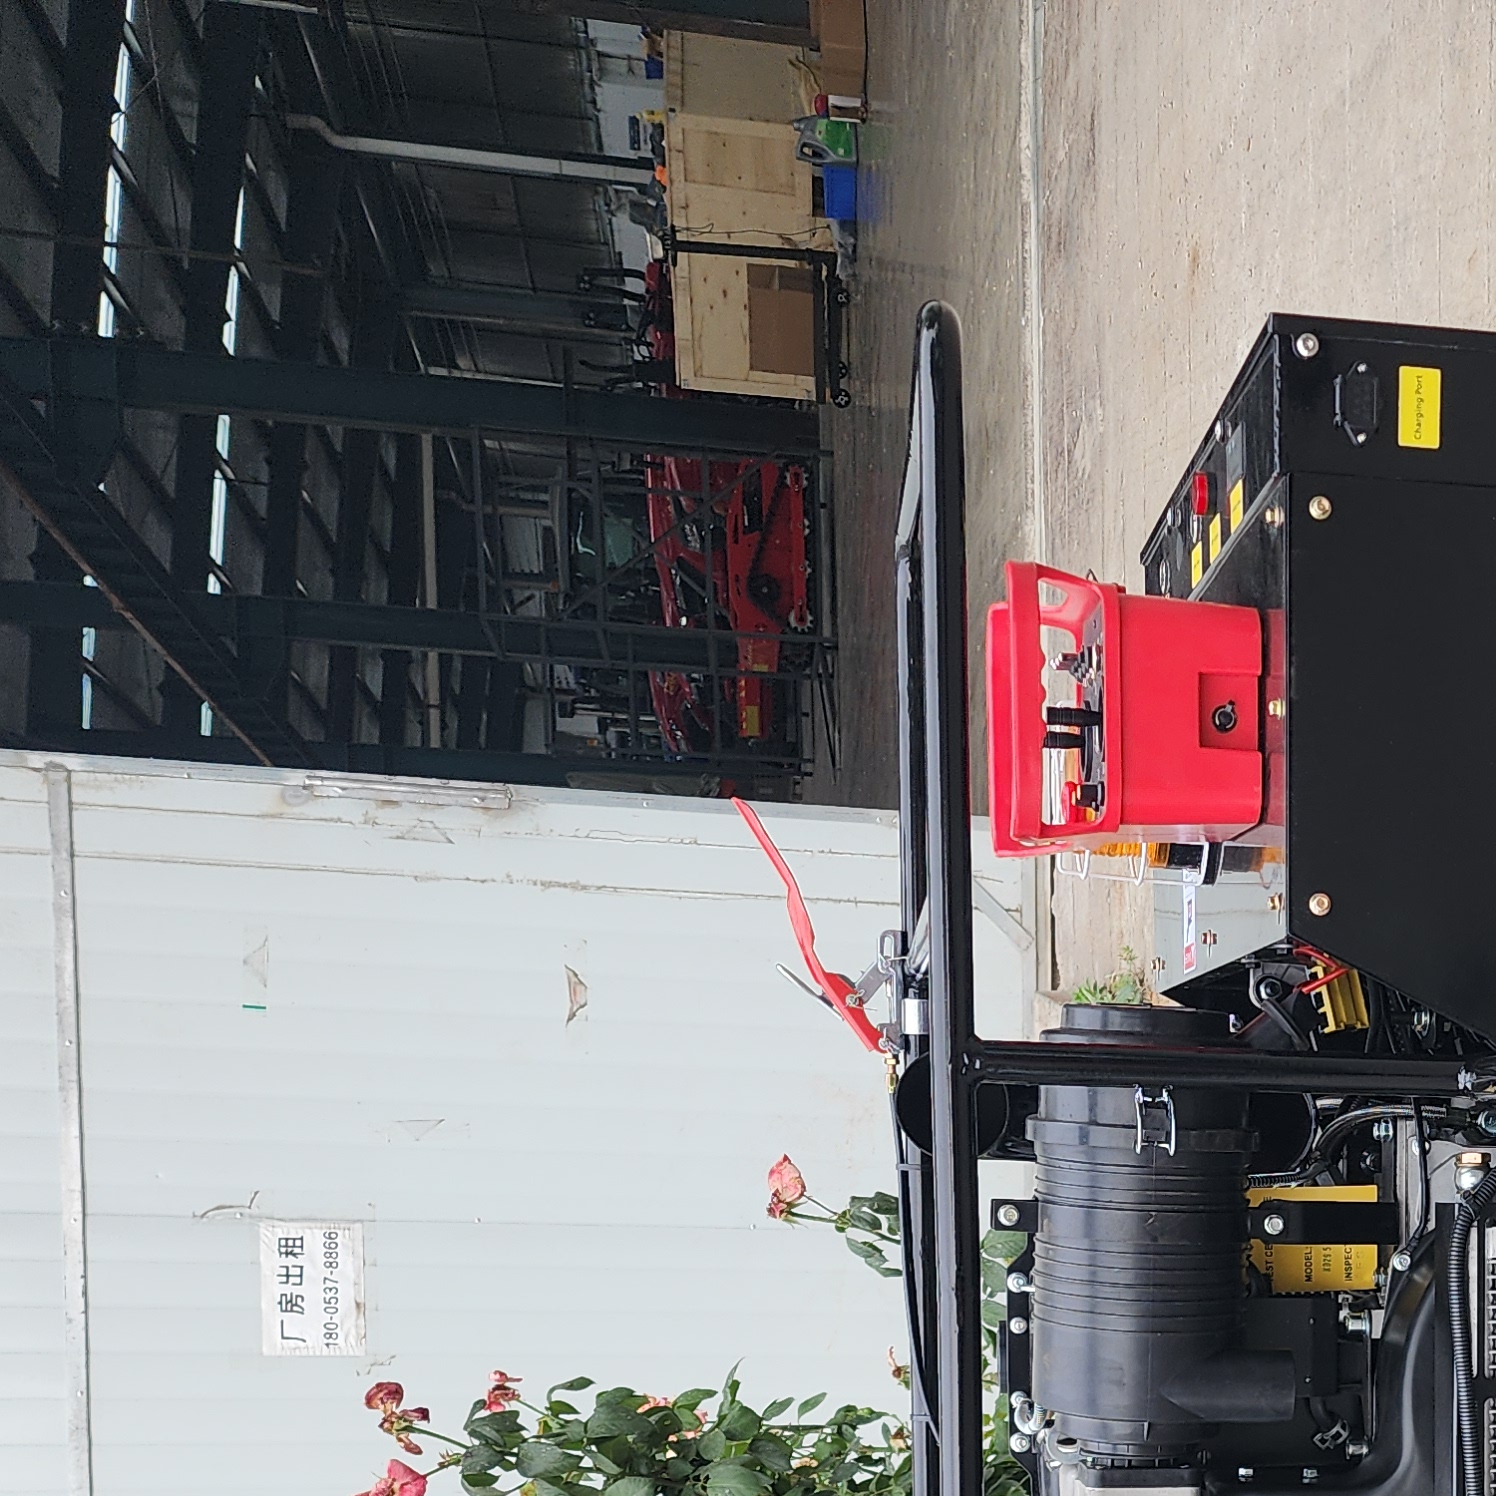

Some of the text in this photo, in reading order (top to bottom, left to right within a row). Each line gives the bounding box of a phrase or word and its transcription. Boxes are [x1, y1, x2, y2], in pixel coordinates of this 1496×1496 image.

[1413, 375, 1425, 440] Charging Port
[276, 1235, 306, 1343] 厂房出租
[323, 1230, 339, 1348] 180-0537-8866
[1304, 1246, 1313, 1283] MODEL:
[1344, 1244, 1353, 1282] INSPEC
